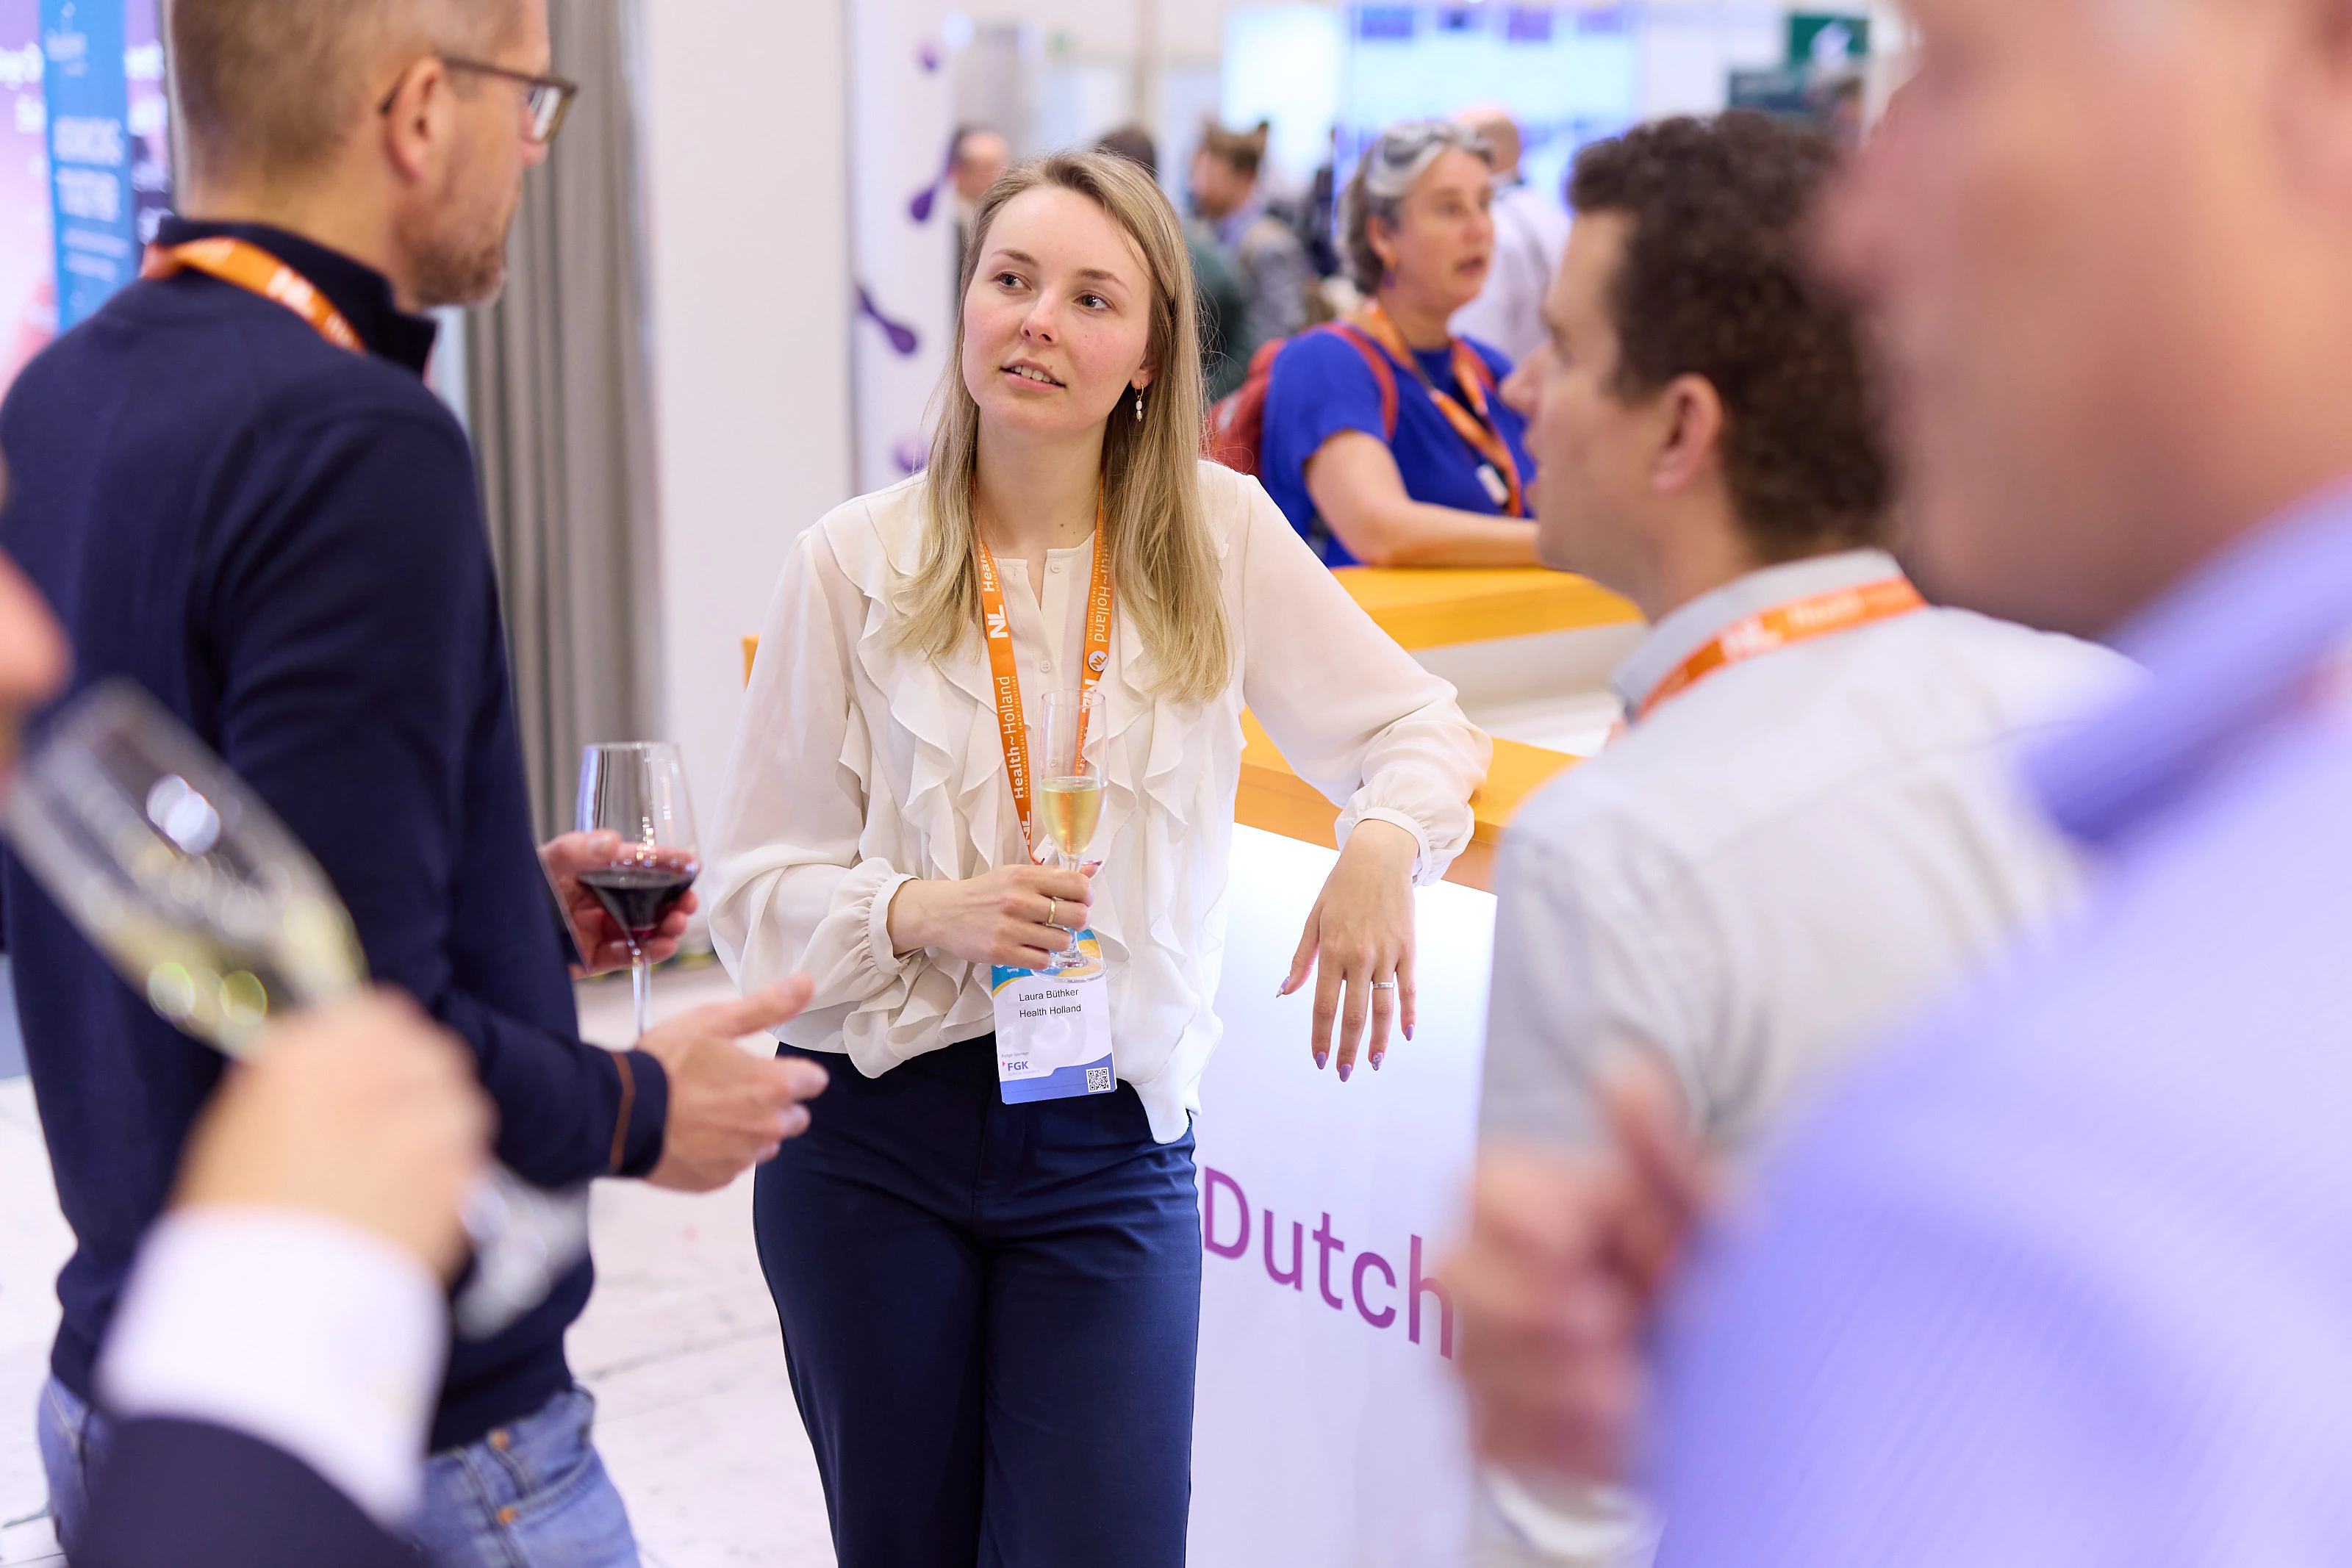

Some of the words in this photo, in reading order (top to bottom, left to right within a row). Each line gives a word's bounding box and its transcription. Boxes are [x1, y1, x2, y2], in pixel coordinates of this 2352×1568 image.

[986, 604, 1008, 639] NL
[1090, 655, 1107, 670] NL
[1011, 675, 1020, 708] SOLUTIONS
[1019, 733, 1028, 772] CHALLENGES,
[1019, 993, 1044, 1001] Laura
[1046, 988, 1079, 999] Büthker
[1019, 1007, 1047, 1018] Health
[1050, 1004, 1081, 1015] Holland
[1008, 1061, 1029, 1071] FGK
[1204, 1166, 1454, 1361] Dutch
